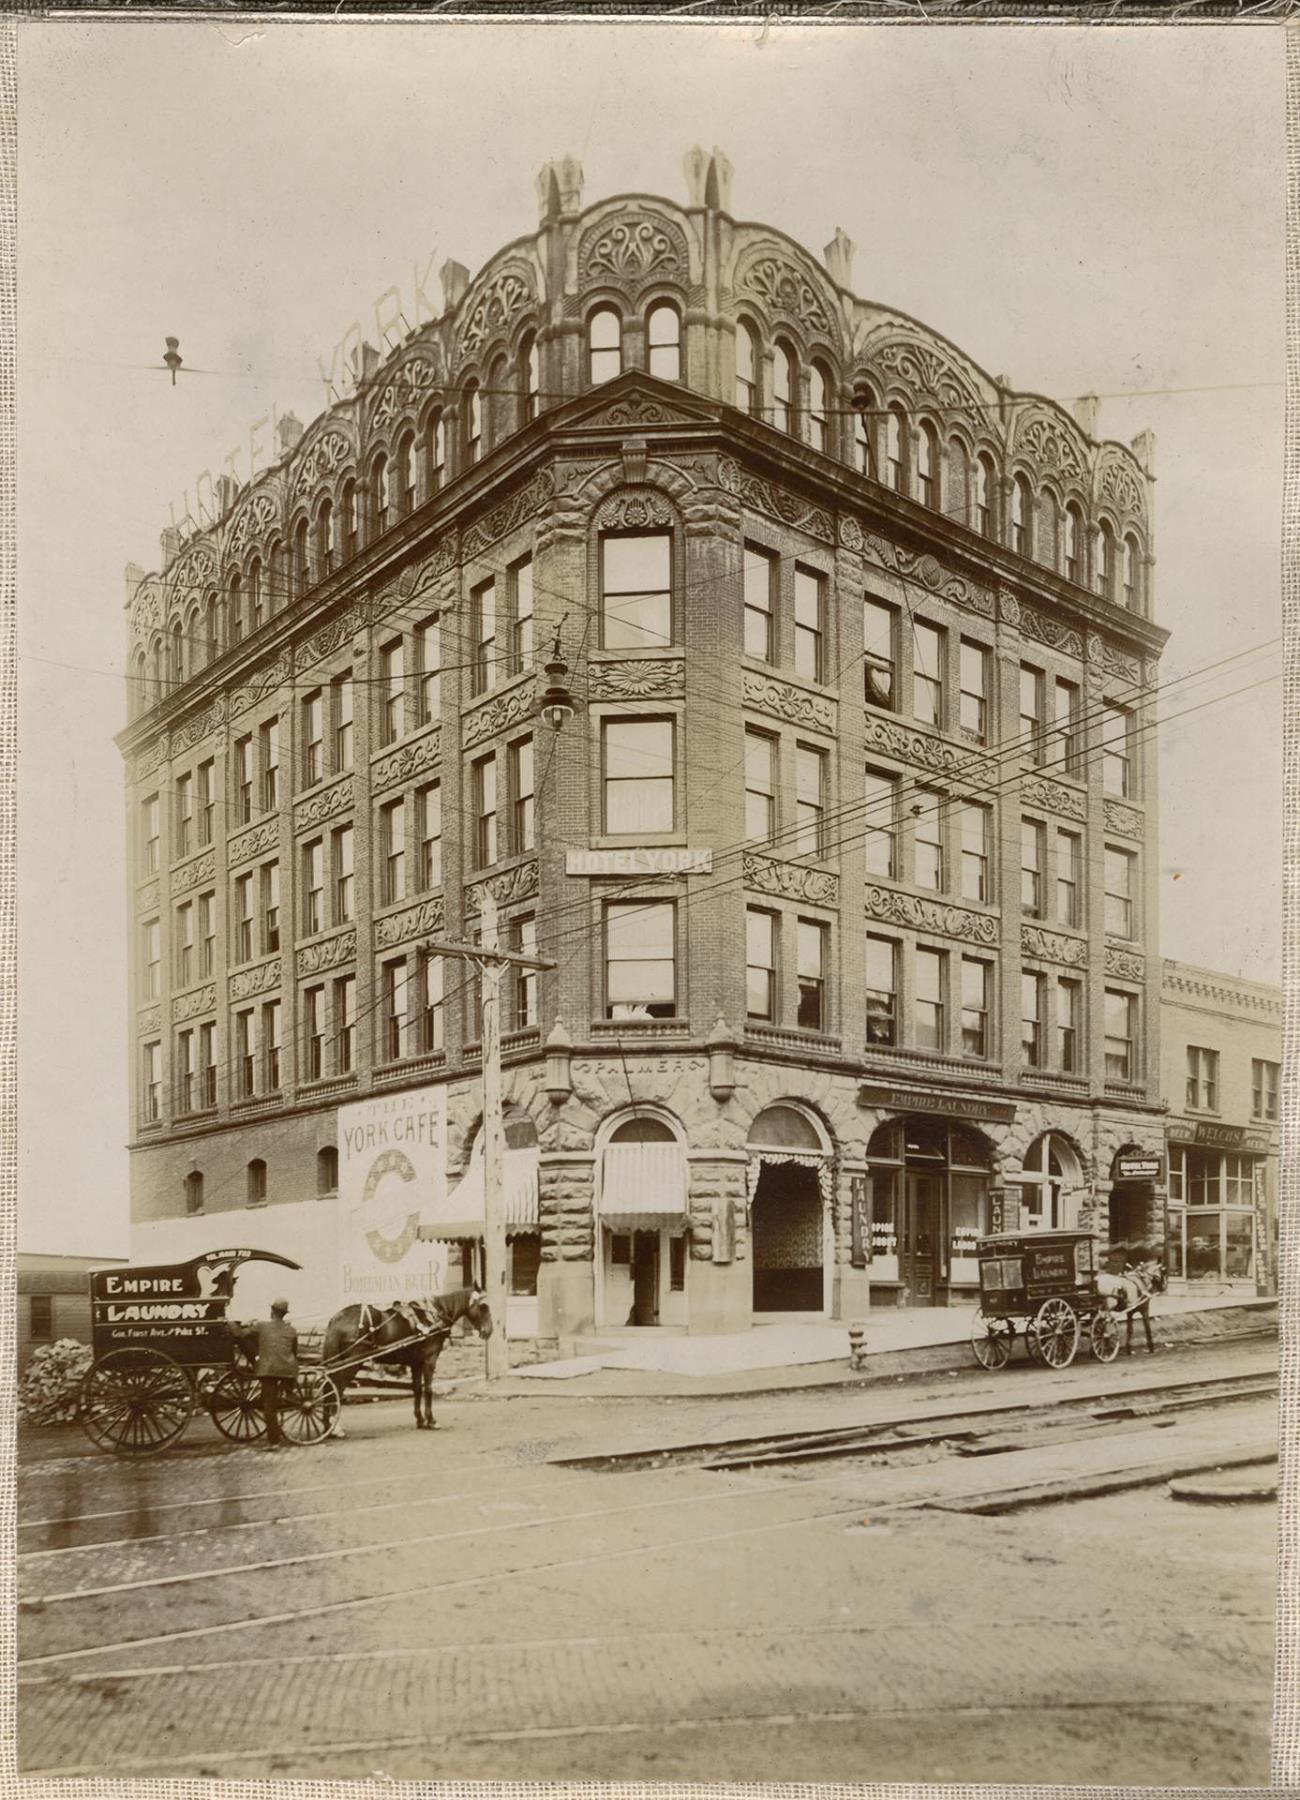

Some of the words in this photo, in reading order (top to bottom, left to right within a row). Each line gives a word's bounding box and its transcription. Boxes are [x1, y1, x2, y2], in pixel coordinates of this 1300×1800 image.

[318, 247, 442, 405] YORK
[570, 850, 641, 872] HOTEL
[646, 849, 710, 872] YORK
[889, 1092, 936, 1109] EMPIRE
[937, 1098, 991, 1116] LAUNDRY
[344, 1119, 388, 1160] YORK
[394, 1110, 440, 1149] CAFE
[855, 1178, 871, 1262] LAUNDRY
[992, 1197, 1002, 1233] LAUN
[1035, 1253, 1065, 1265] EMPIRE
[1032, 1266, 1069, 1280] LAUNDRY
[106, 1277, 184, 1294] EMPIRE
[107, 1303, 211, 1322] LAUNDRY
